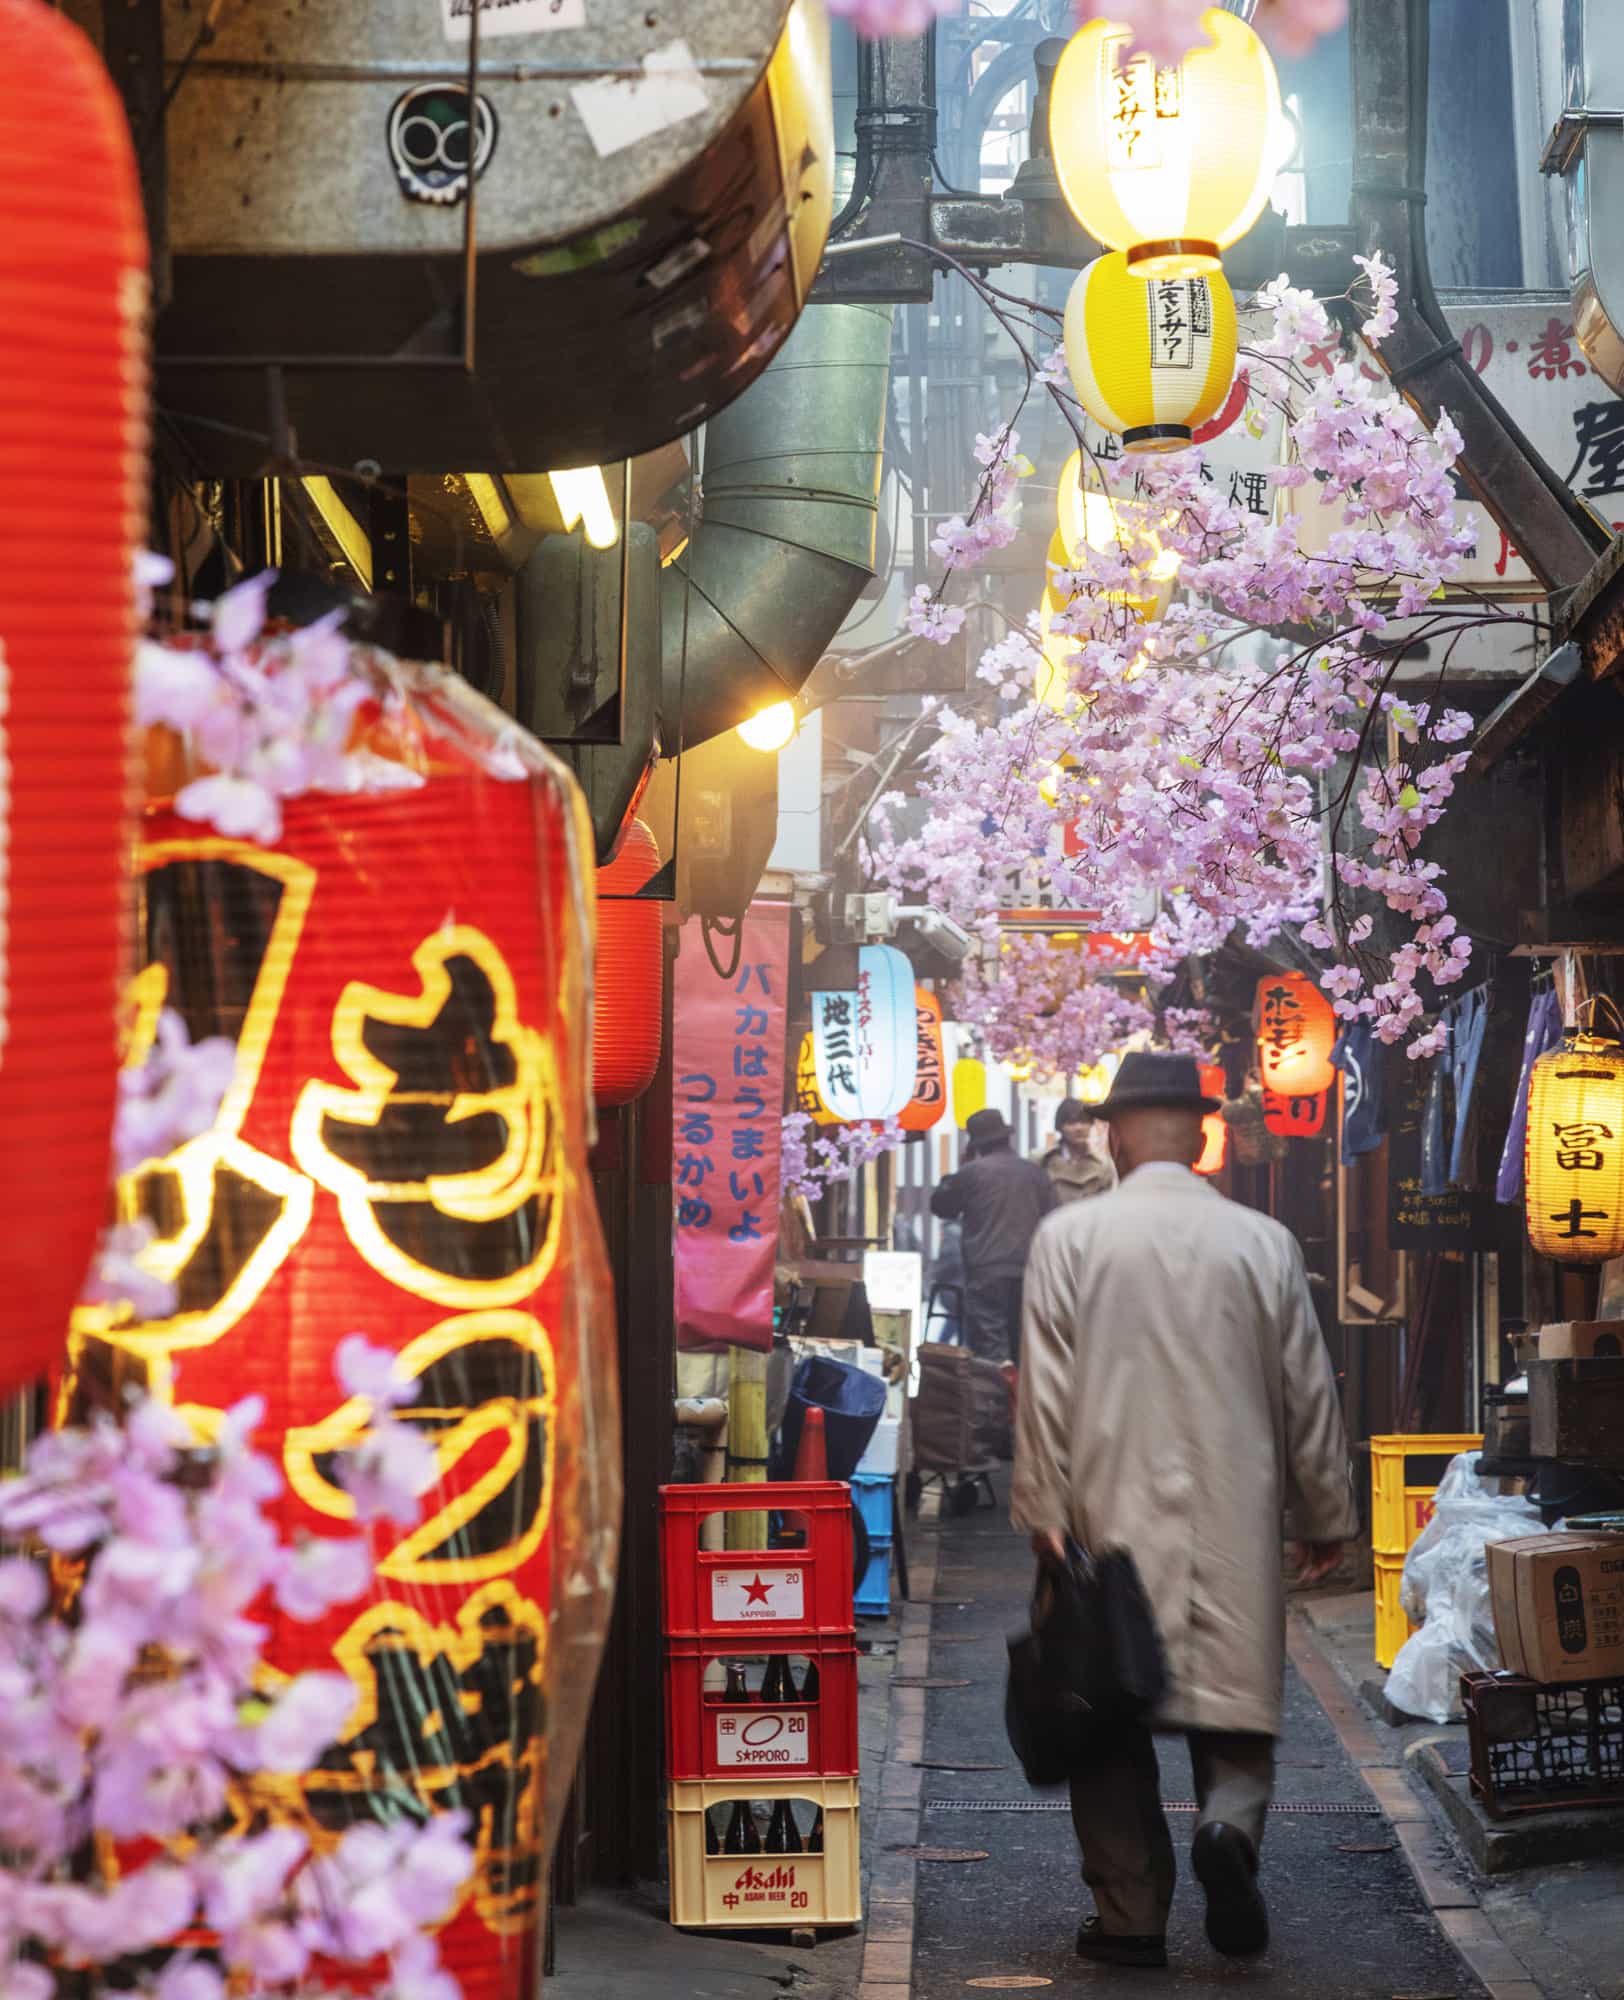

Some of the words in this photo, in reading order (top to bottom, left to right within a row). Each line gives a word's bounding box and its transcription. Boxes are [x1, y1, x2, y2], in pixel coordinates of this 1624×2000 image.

[1110, 57, 1147, 160] モンサワー
[728, 963, 771, 1242] バカはうまいよ
[677, 1073, 717, 1228] つるかめ
[786, 1573, 799, 1584] 20
[740, 1610, 776, 1618] SAPPORO
[788, 1717, 805, 1733] 20
[735, 1865, 795, 1889] Asahi
[722, 1892, 739, 1910] 中
[768, 1892, 786, 1901] BEER
[790, 1892, 808, 1908] 20
